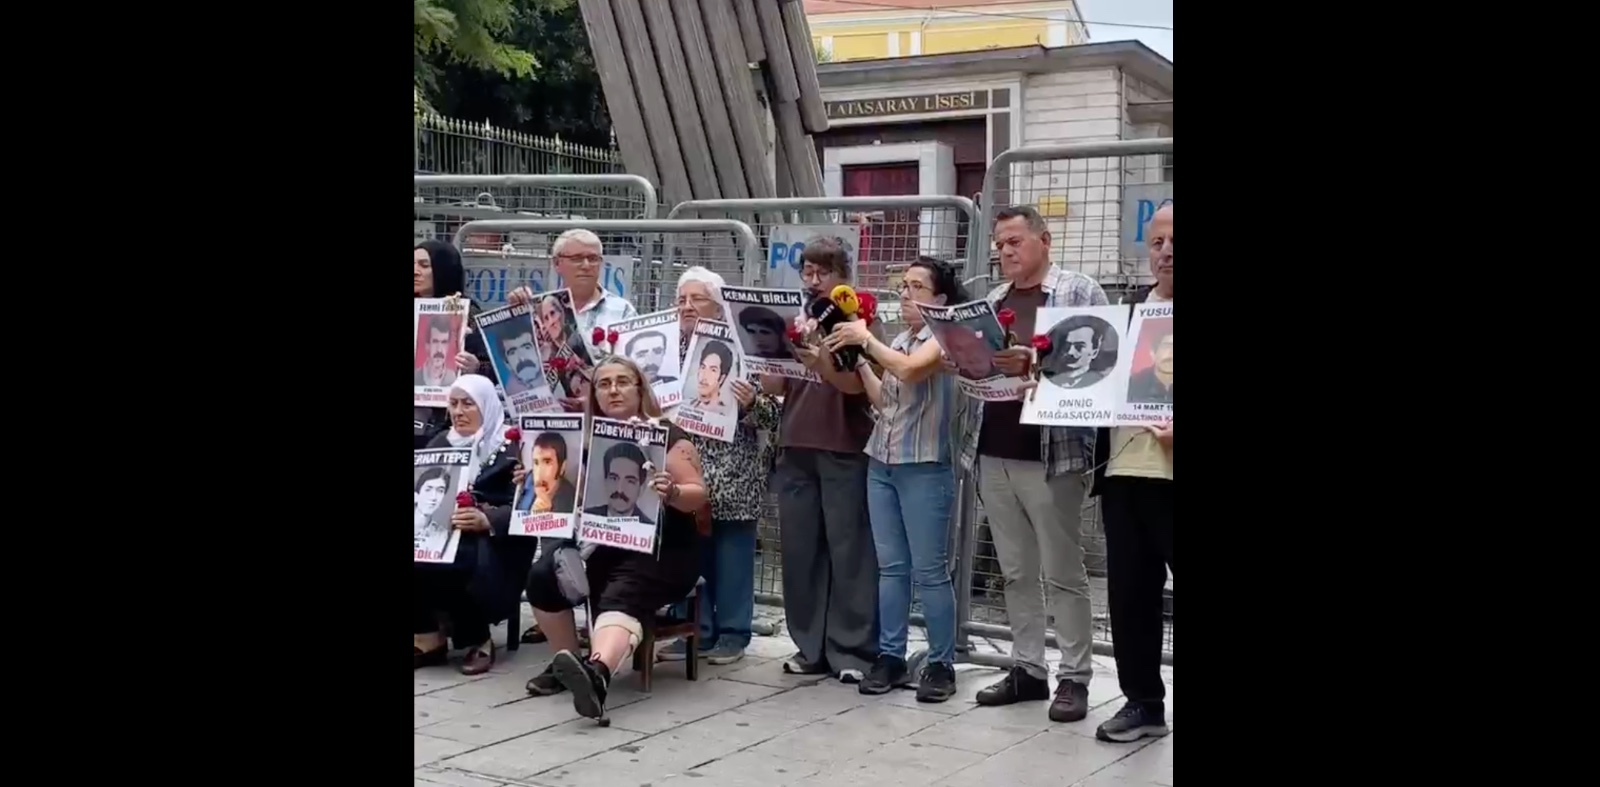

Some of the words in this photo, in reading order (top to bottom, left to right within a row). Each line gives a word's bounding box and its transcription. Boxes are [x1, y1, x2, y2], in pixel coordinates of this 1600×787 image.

[924, 89, 975, 109] LİSESİ
[723, 291, 760, 302] KEMAL
[762, 292, 799, 304] BİRLİK
[1140, 307, 1173, 317] YUSU
[594, 422, 633, 440] ZÜBEYİR
[443, 452, 469, 463] TEPE
[525, 517, 568, 533] KAYBEDİLDİ
[582, 527, 653, 549] KAYBEDİLDİ
